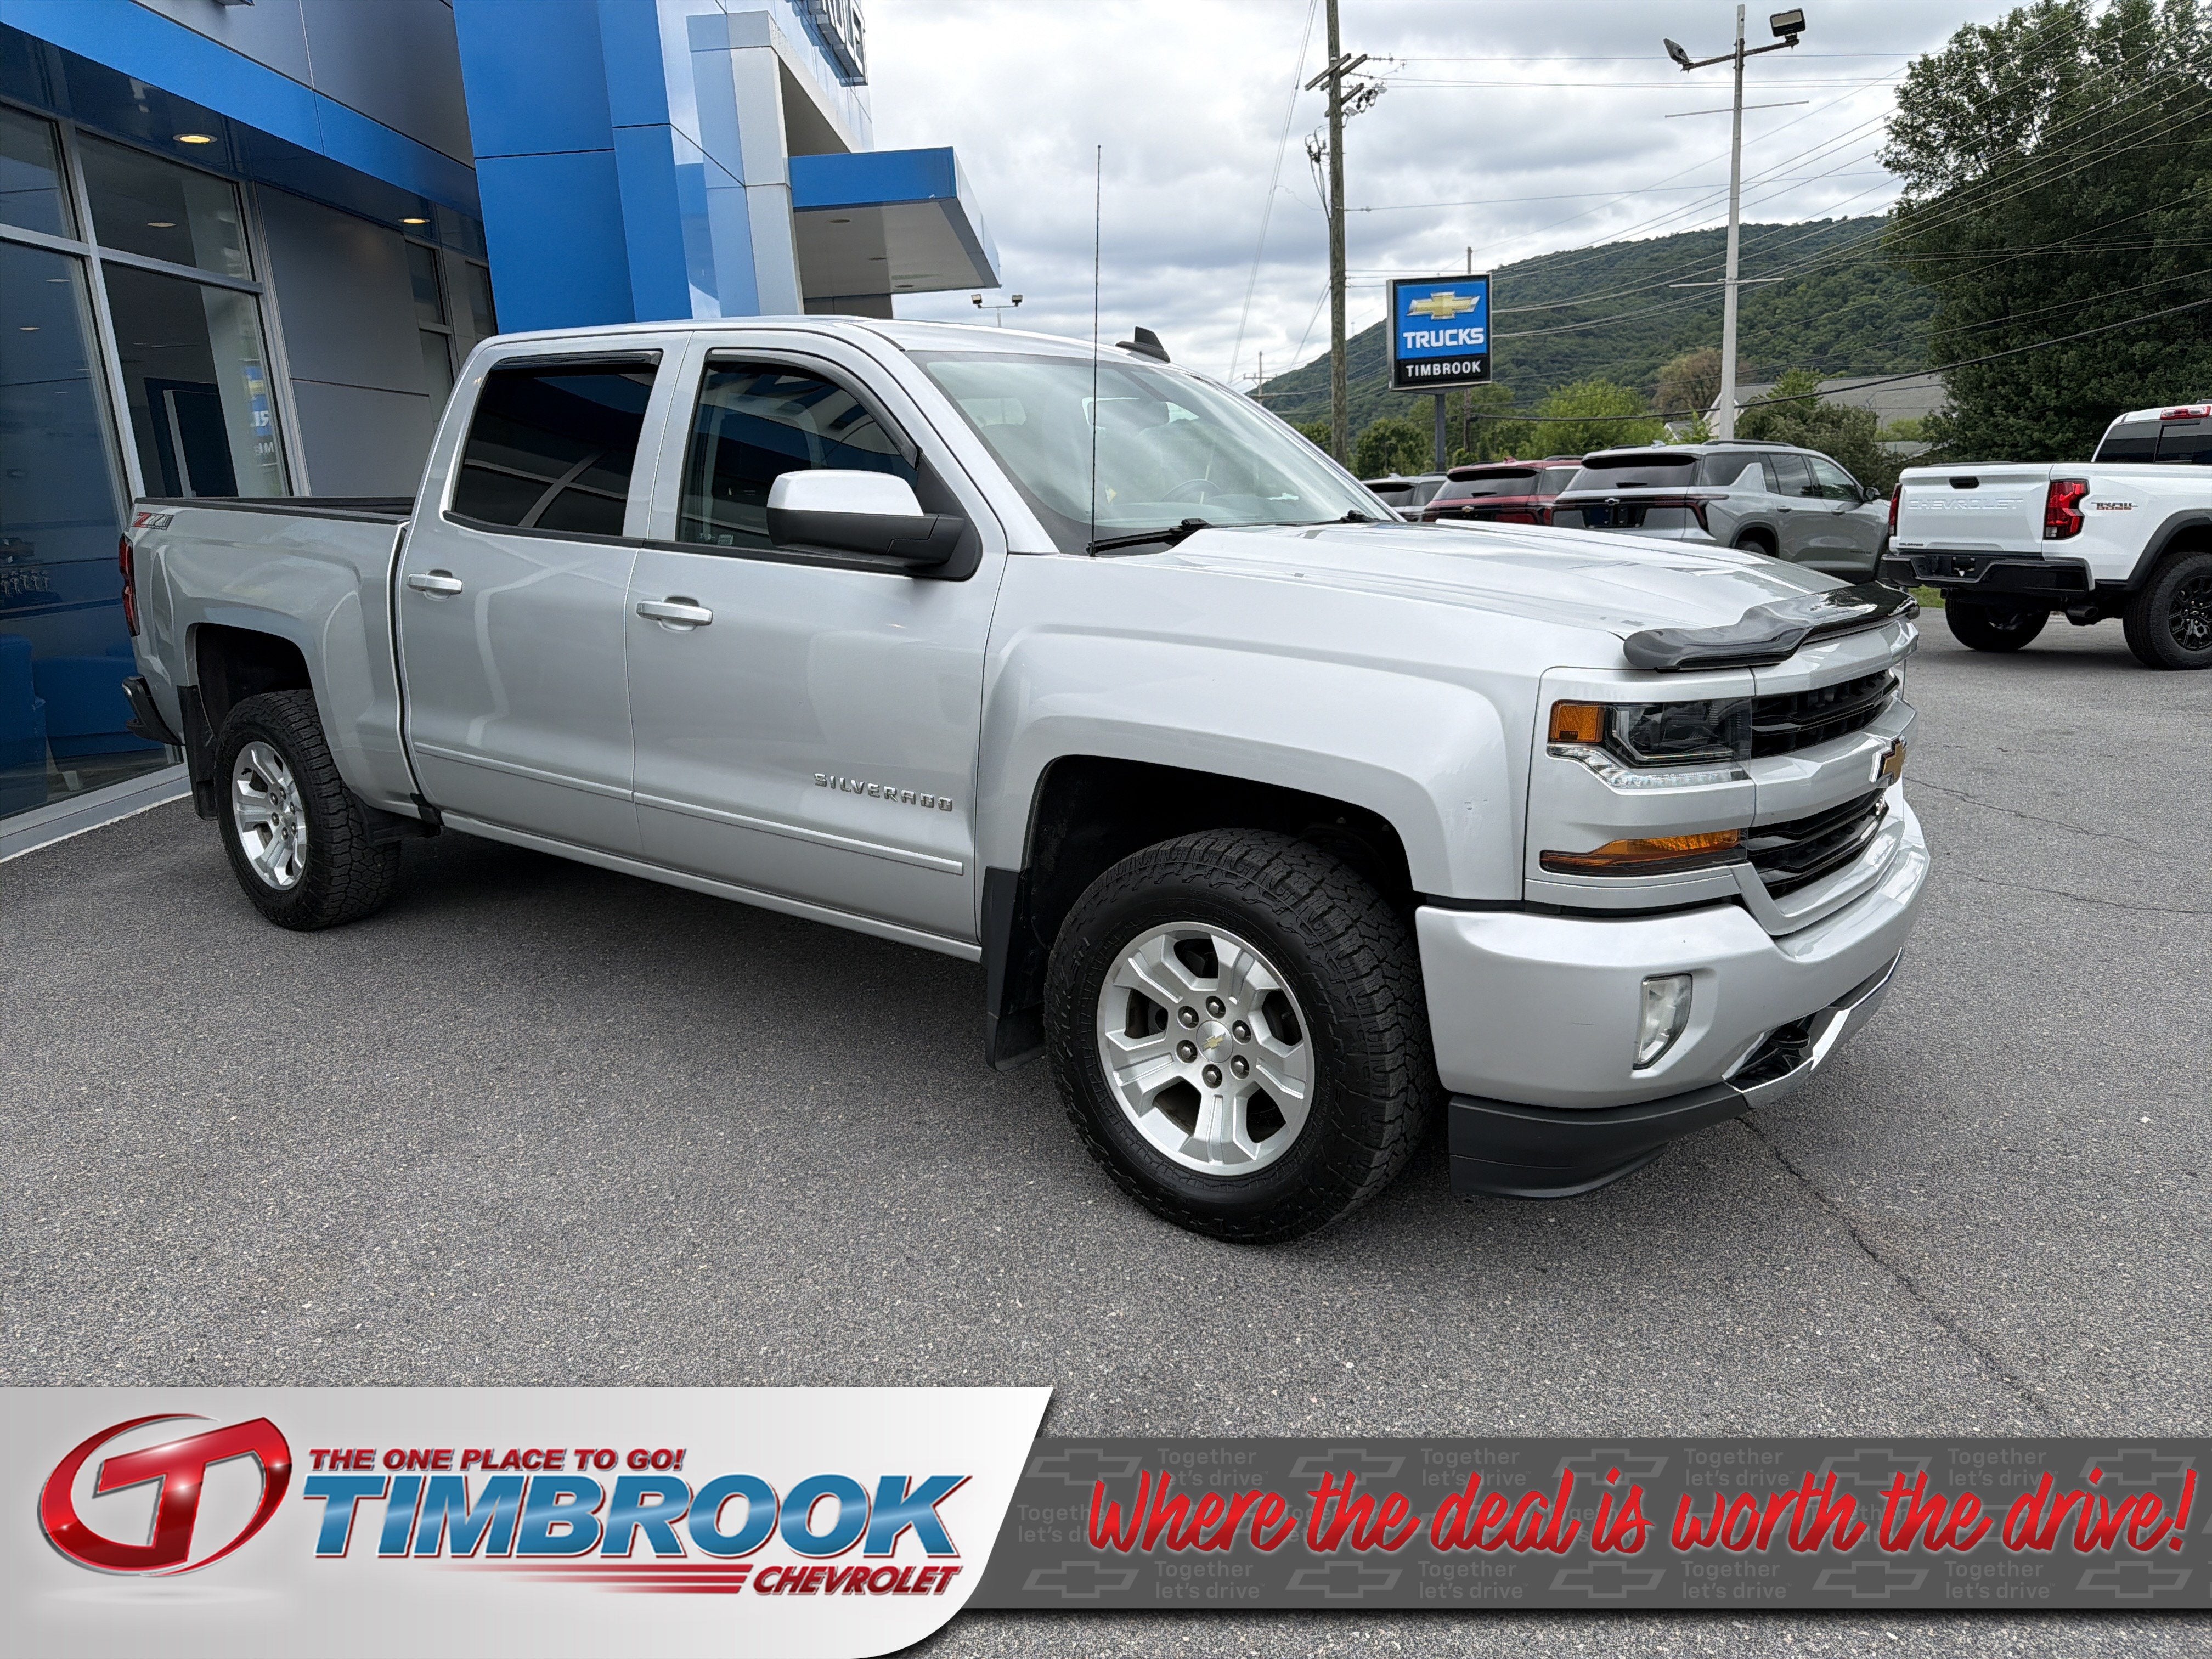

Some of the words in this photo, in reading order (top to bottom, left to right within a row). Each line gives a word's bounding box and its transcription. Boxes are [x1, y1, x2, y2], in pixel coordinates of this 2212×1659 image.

[1403, 328, 1484, 349] TRUCKS
[1406, 360, 1481, 377] TIMBROOK
[131, 512, 174, 528] Z71
[814, 773, 952, 812] SILVERADO
